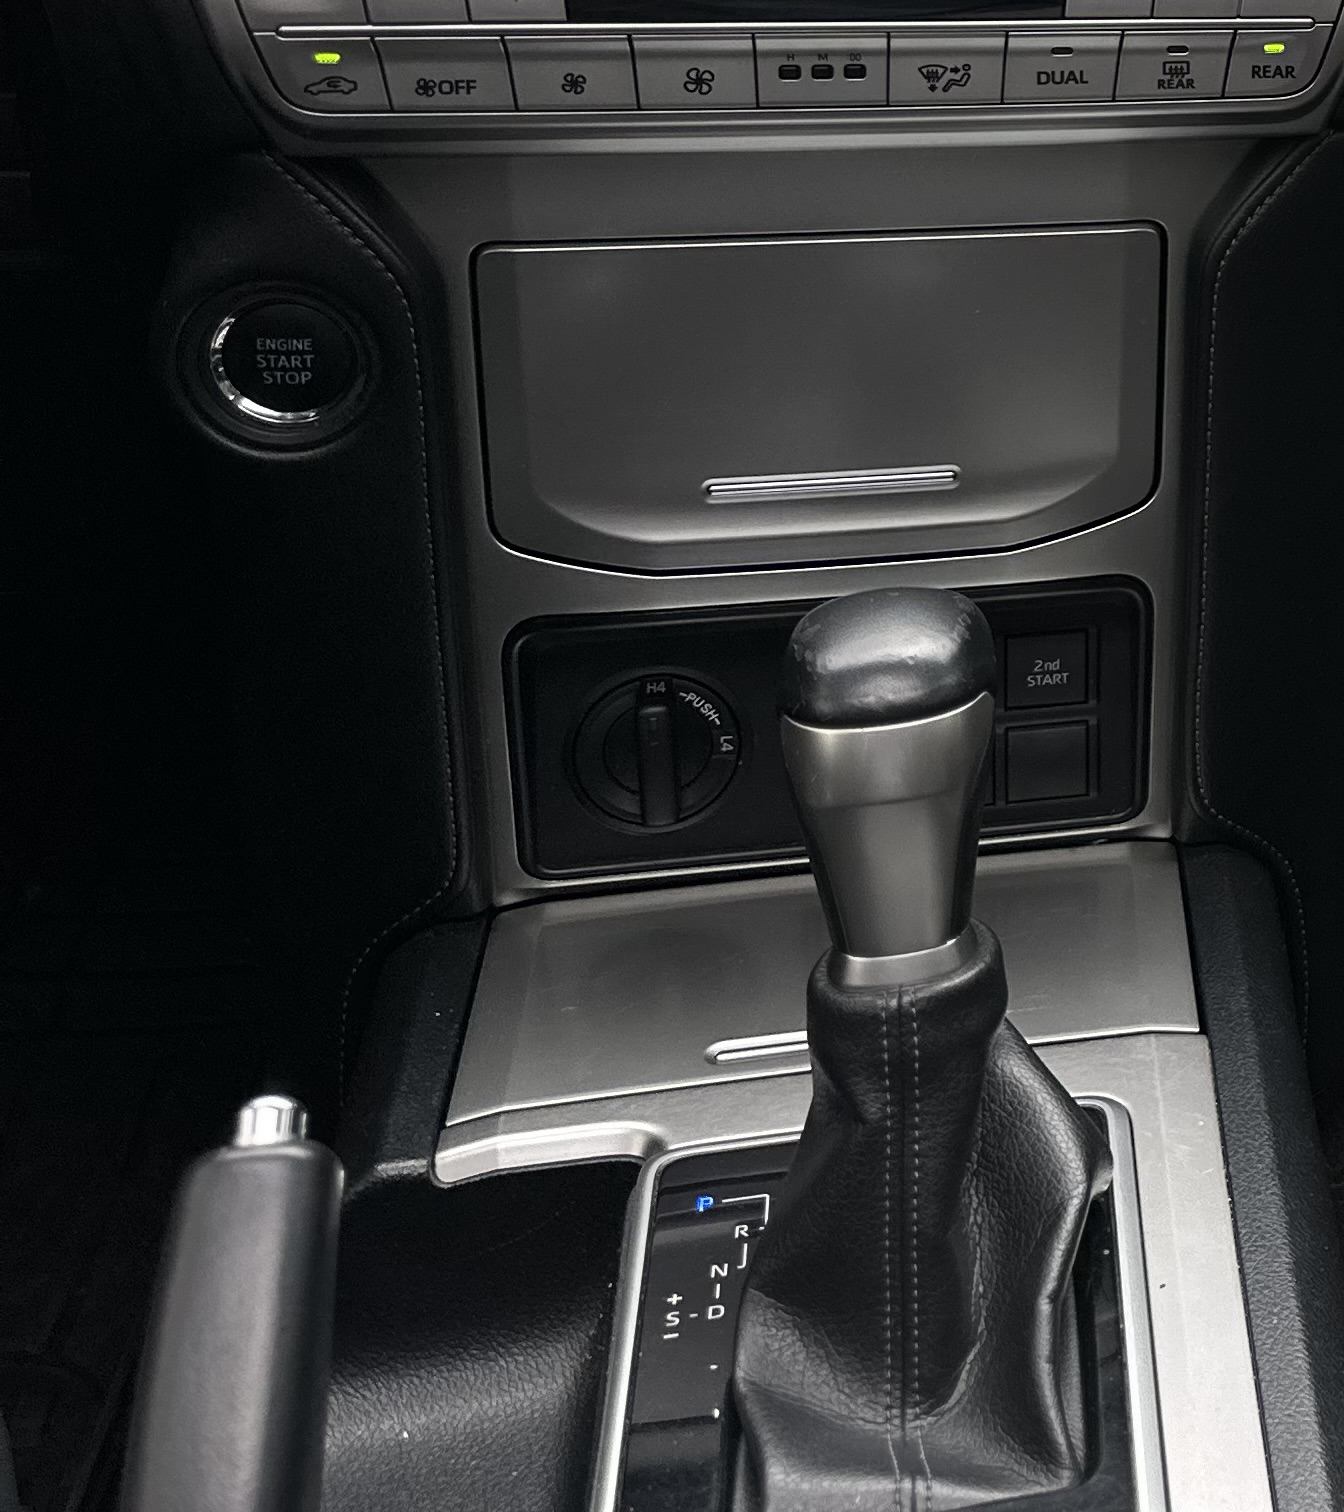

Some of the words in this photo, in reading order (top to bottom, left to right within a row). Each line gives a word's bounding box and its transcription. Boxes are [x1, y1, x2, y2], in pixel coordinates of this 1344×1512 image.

[1036, 70, 1089, 86] DUAL
[1251, 65, 1297, 81] REAR
[438, 79, 477, 97] OFF
[1157, 77, 1196, 90] REAR
[256, 337, 313, 351] ENGINE
[255, 354, 315, 368] START
[262, 371, 312, 385] STOP
[1033, 658, 1061, 673] 2nd
[1026, 671, 1070, 688] START
[645, 681, 667, 694] H4
[719, 735, 735, 753] L4
[695, 1195, 714, 1213] P
[734, 1224, 749, 1238] R
[710, 1263, 729, 1278] N
[665, 1311, 680, 1326] S
[707, 1305, 725, 1319] D
